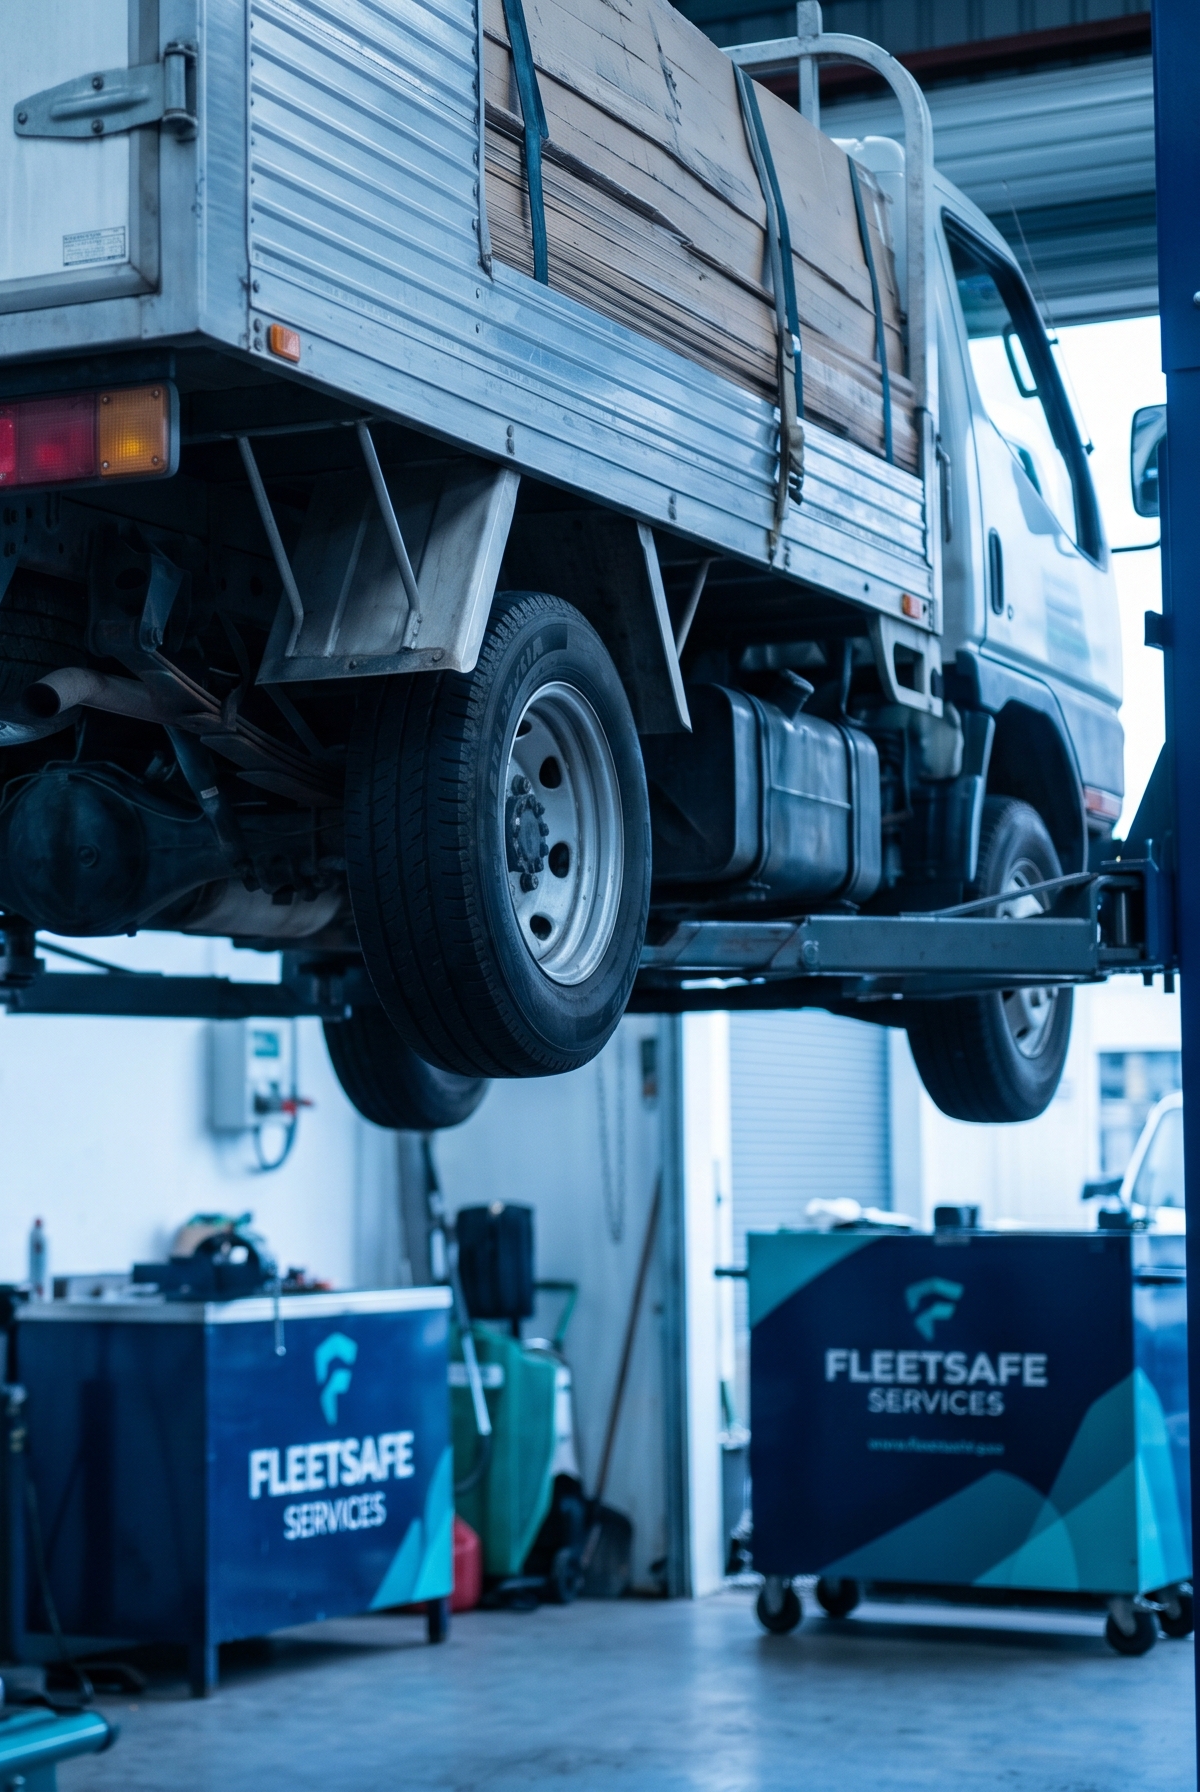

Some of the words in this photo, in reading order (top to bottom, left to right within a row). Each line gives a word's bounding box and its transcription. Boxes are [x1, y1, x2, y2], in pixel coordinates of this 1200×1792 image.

[825, 1348, 1048, 1387] FLEETSAFE
[867, 1387, 1005, 1417] SERVICES
[249, 1431, 414, 1499] FLEETSAFE
[284, 1491, 386, 1540] SERVICES
